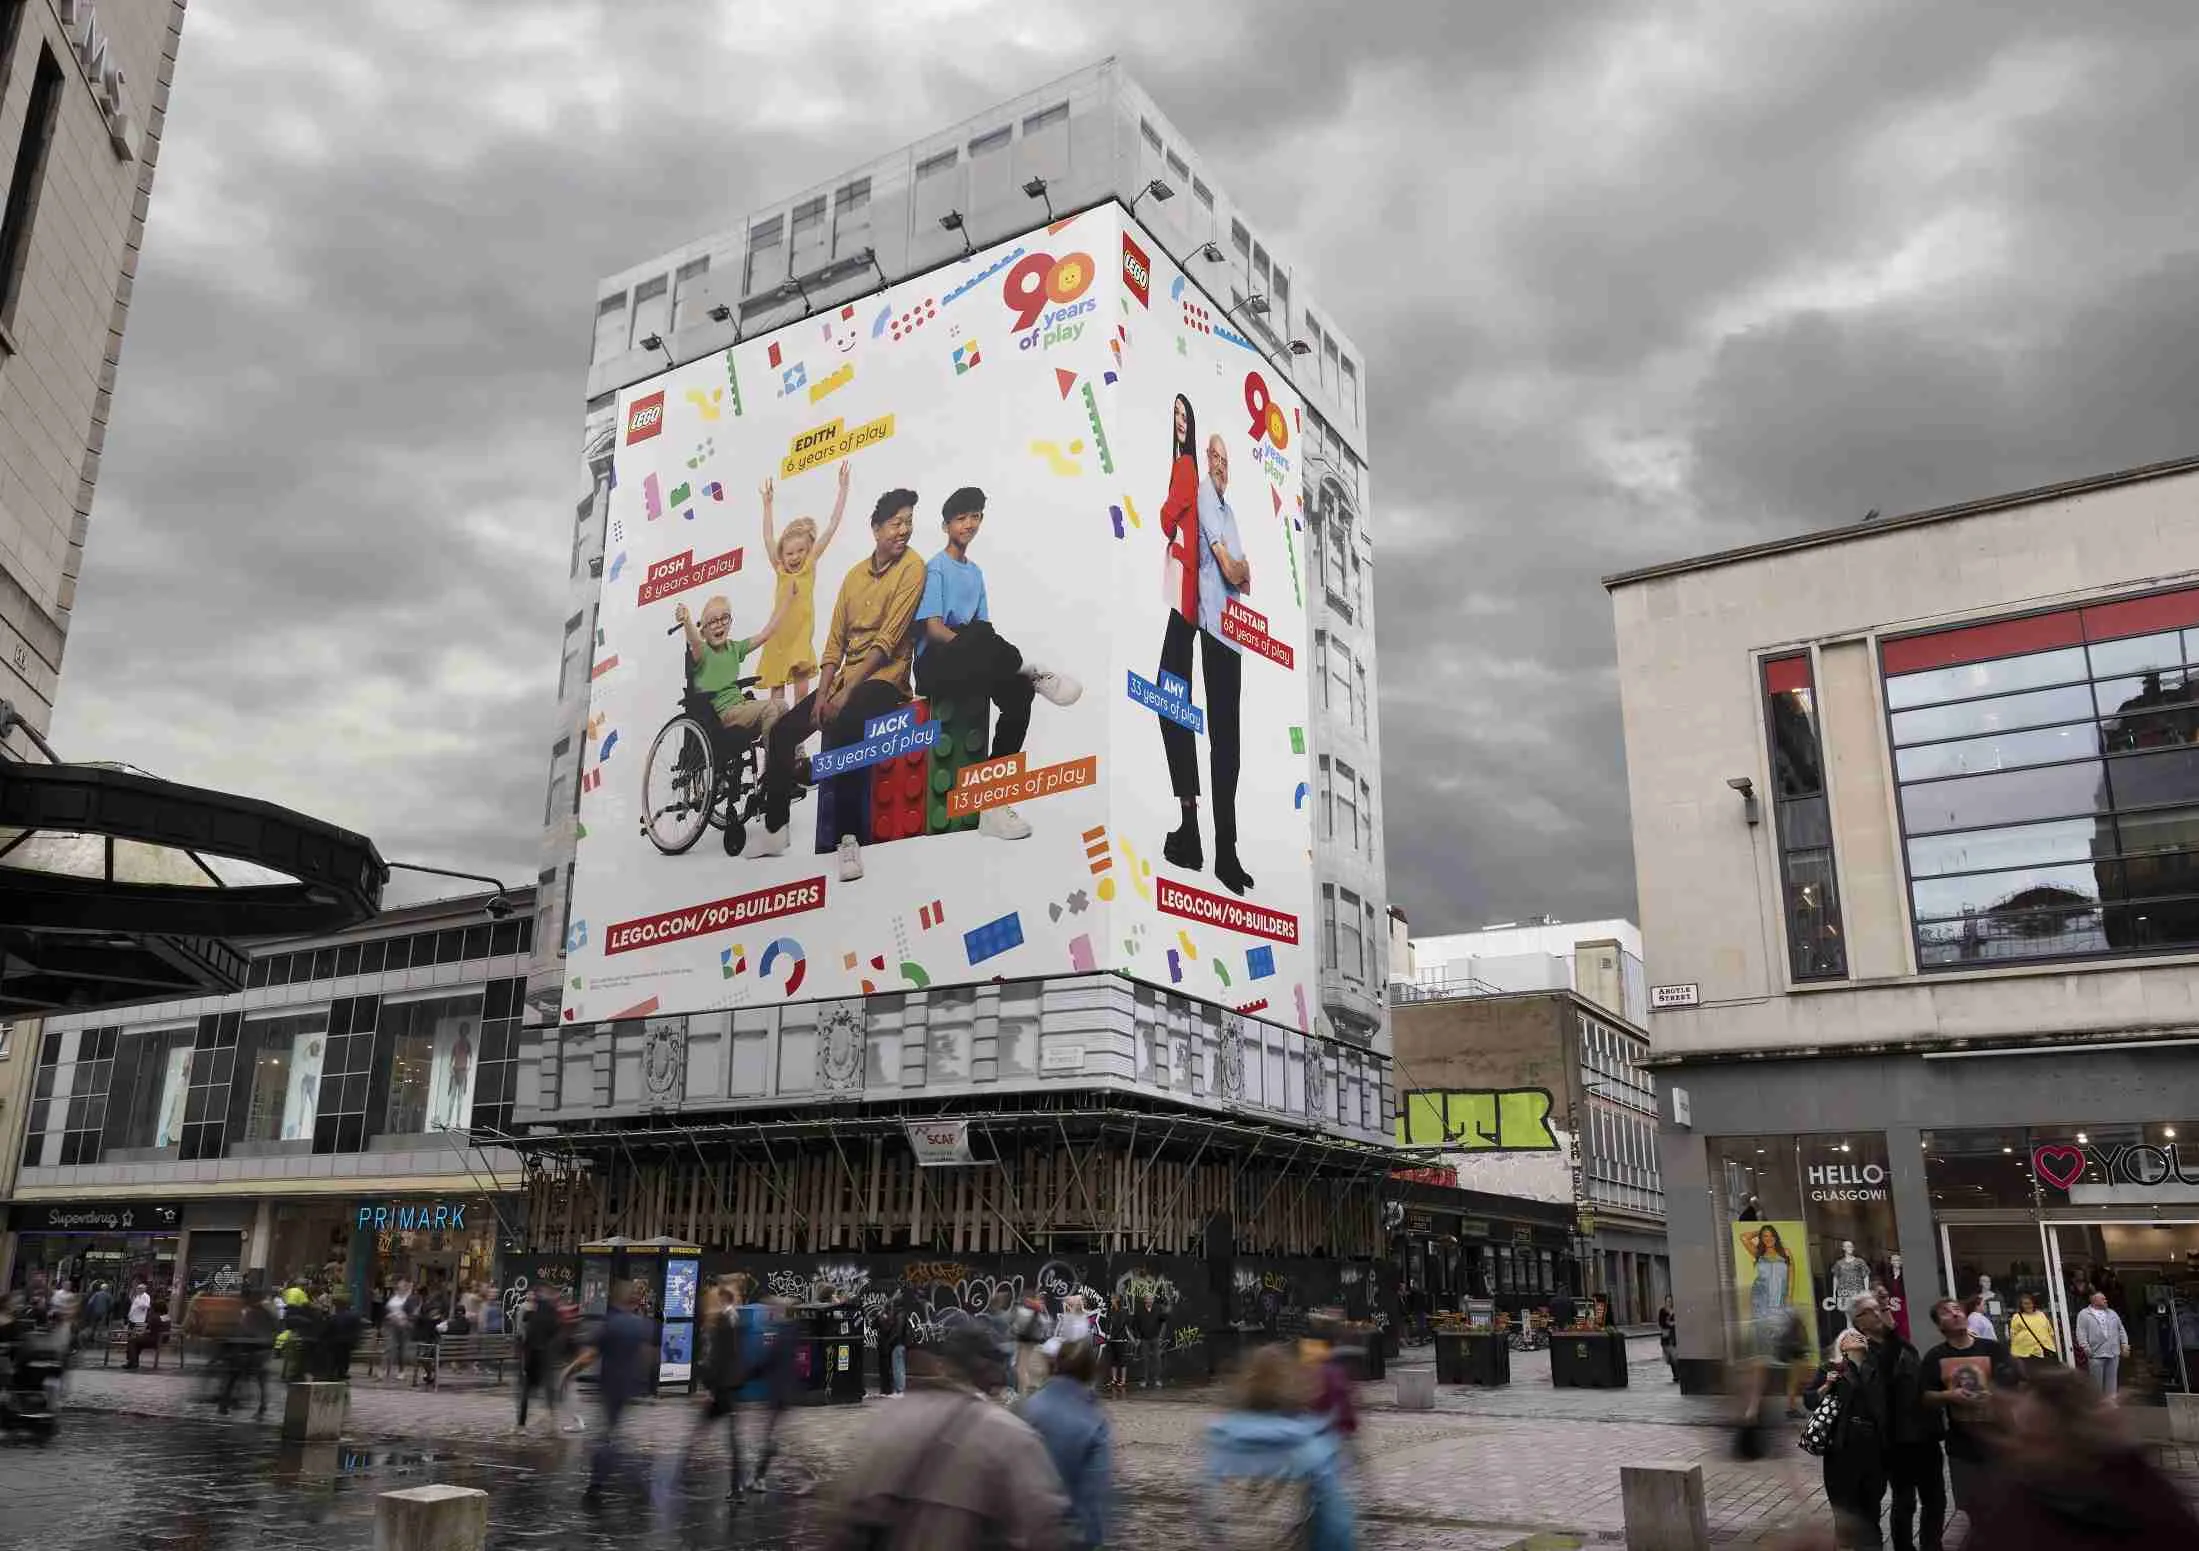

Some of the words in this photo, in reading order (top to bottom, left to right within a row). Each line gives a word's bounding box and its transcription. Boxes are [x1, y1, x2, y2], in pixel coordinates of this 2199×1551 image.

[1124, 250, 1149, 291] LEGO
[1044, 297, 1096, 330] years
[1020, 327, 1040, 350] of
[1043, 322, 1084, 350] play
[630, 405, 662, 431] LEGO
[787, 456, 794, 472] 6
[799, 444, 835, 471] years
[839, 433, 854, 453] of
[856, 423, 887, 449] play
[795, 425, 836, 452] EDITH
[1252, 447, 1263, 465] of
[644, 585, 653, 600] 8
[655, 574, 689, 599] years
[692, 563, 706, 584] of
[707, 556, 735, 580] play
[652, 557, 685, 580] JOSH
[1228, 604, 1266, 634] ALISTAIR
[1223, 618, 1234, 634] 68
[1236, 625, 1259, 648] years
[1261, 638, 1271, 656] of
[1271, 643, 1290, 665] play
[1164, 678, 1184, 699] AMY
[1130, 678, 1142, 697] 33
[1143, 687, 1168, 712] years
[1170, 700, 1180, 720] of
[1181, 703, 1201, 730] play
[868, 712, 909, 739] JACK
[816, 755, 832, 773] 33
[836, 744, 877, 770] years
[882, 734, 899, 756] of
[900, 727, 934, 753] play
[953, 792, 969, 810] 13
[973, 781, 1020, 810] years
[1025, 772, 1044, 794] of
[1046, 766, 1086, 791] play
[962, 761, 1017, 788] JACOB
[611, 885, 819, 948] LEGO.COM/90-BUILDERS
[1161, 886, 1295, 938] LEGO.COM/90-BUILDERS
[1808, 1164, 1884, 1185] HELLO
[1811, 1190, 1888, 1202] GLASGOW!
[49, 1208, 119, 1229] Superdrug
[358, 1204, 467, 1231] PRIMARK
